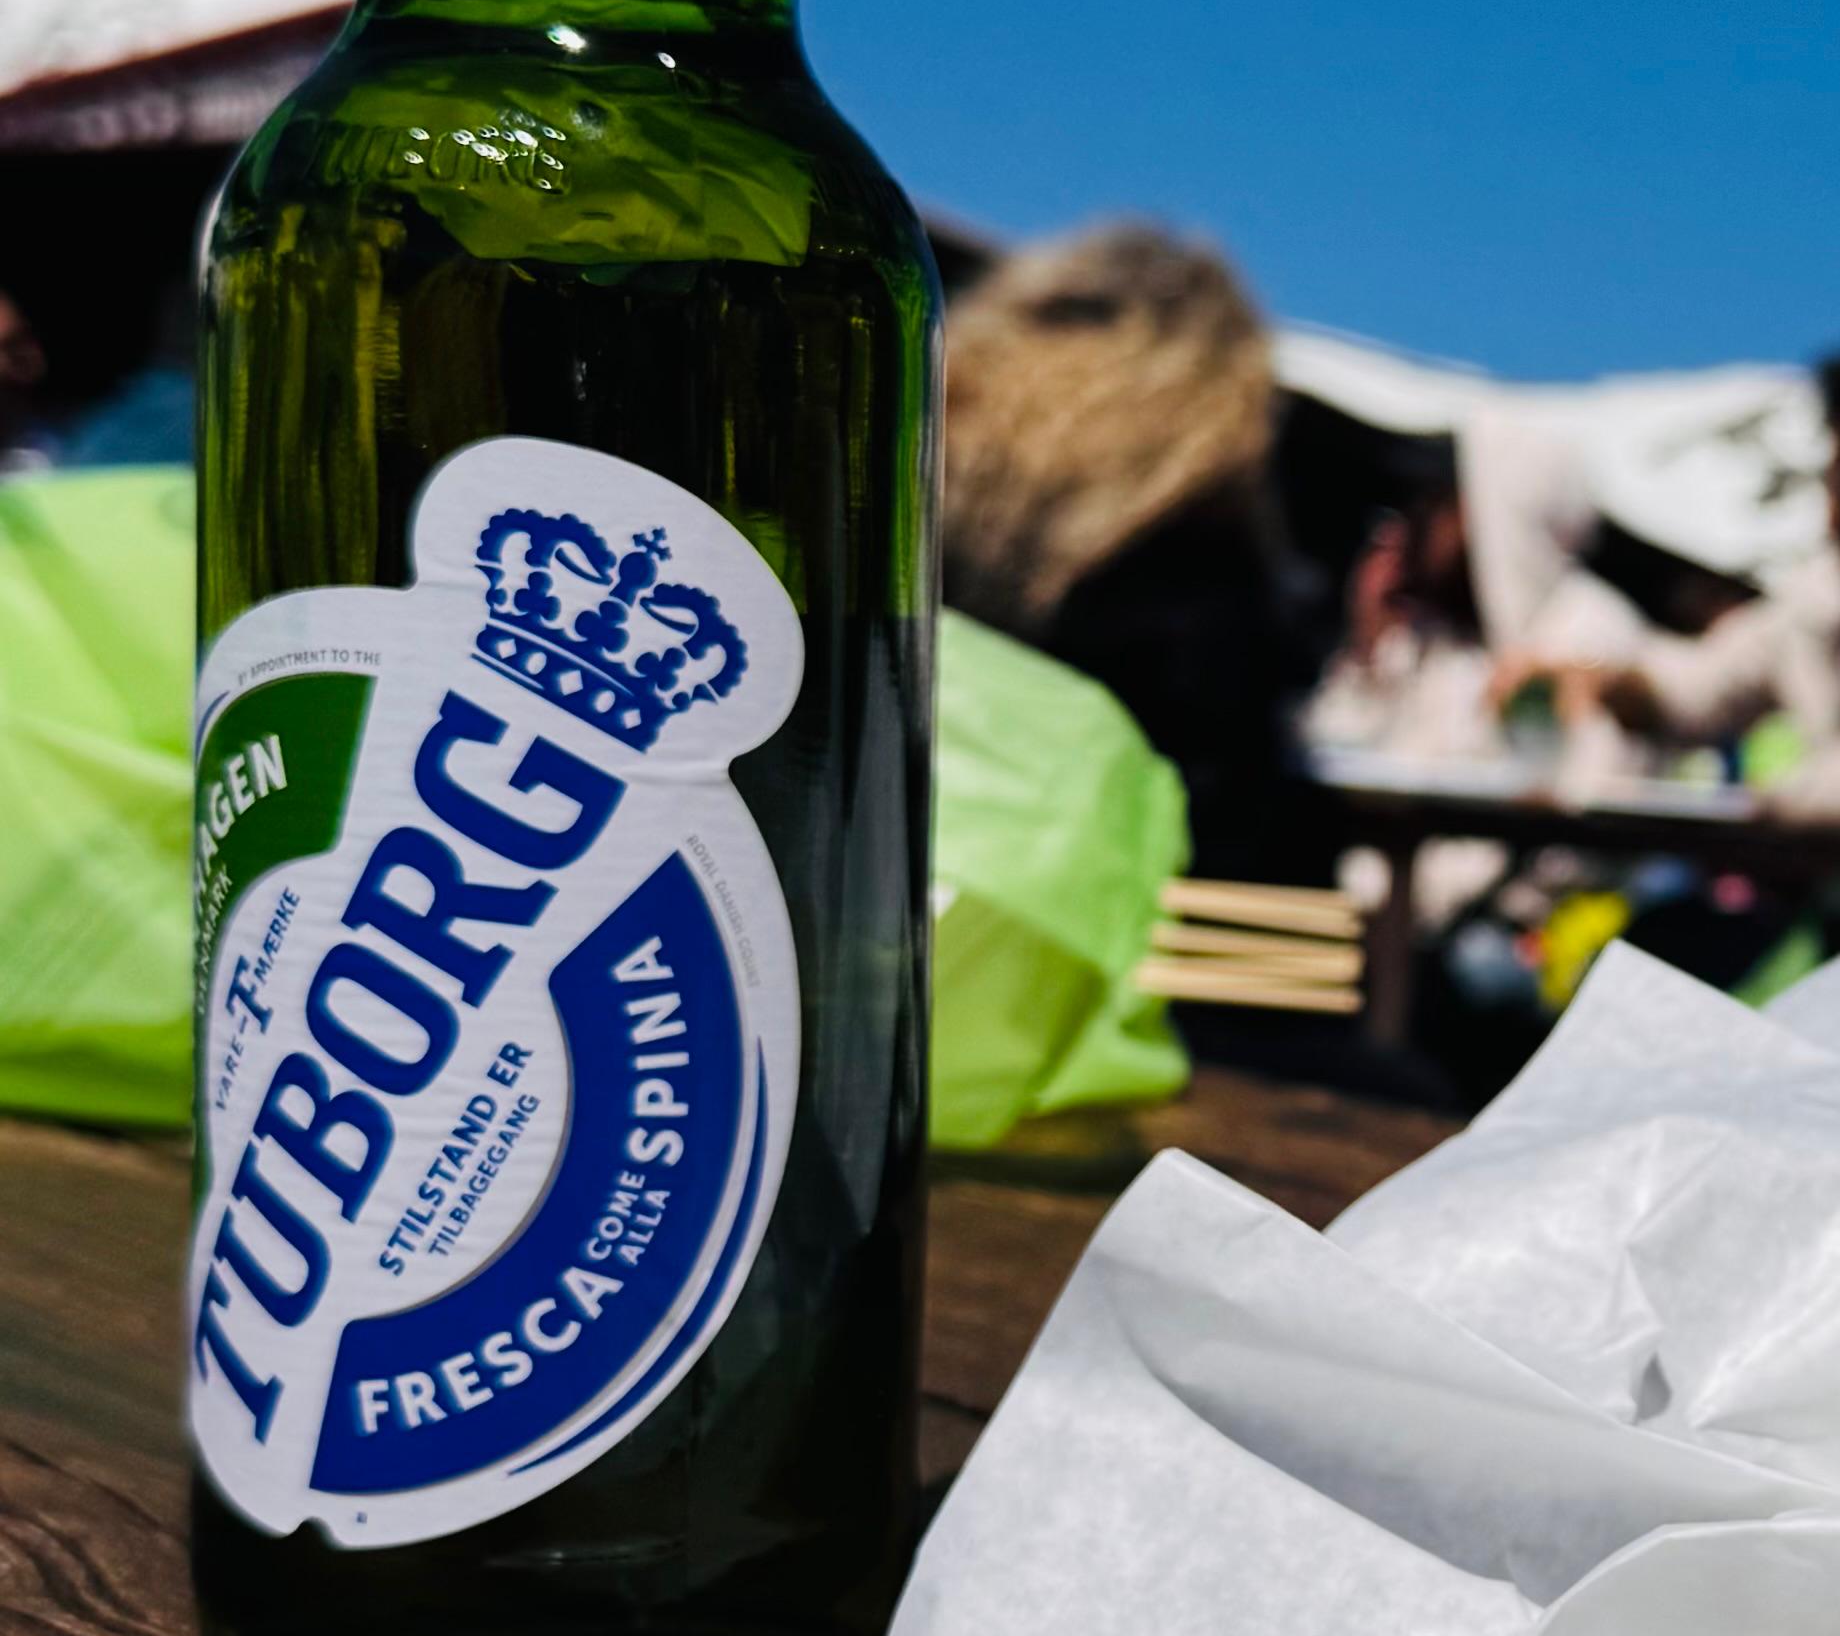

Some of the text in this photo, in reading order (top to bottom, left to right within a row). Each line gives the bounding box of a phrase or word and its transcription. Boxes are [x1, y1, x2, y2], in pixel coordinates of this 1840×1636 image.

[331, 648, 350, 663] TO
[354, 649, 382, 666] THE
[686, 833, 719, 878] ROYAL
[197, 688, 628, 1446] TUBORG
[378, 1041, 535, 1277] STILSTAND ER
[428, 1093, 541, 1256] TILBAGEGANG
[613, 934, 691, 1266] ALLA SPINA
[356, 1169, 647, 1437] FRESCA COME
